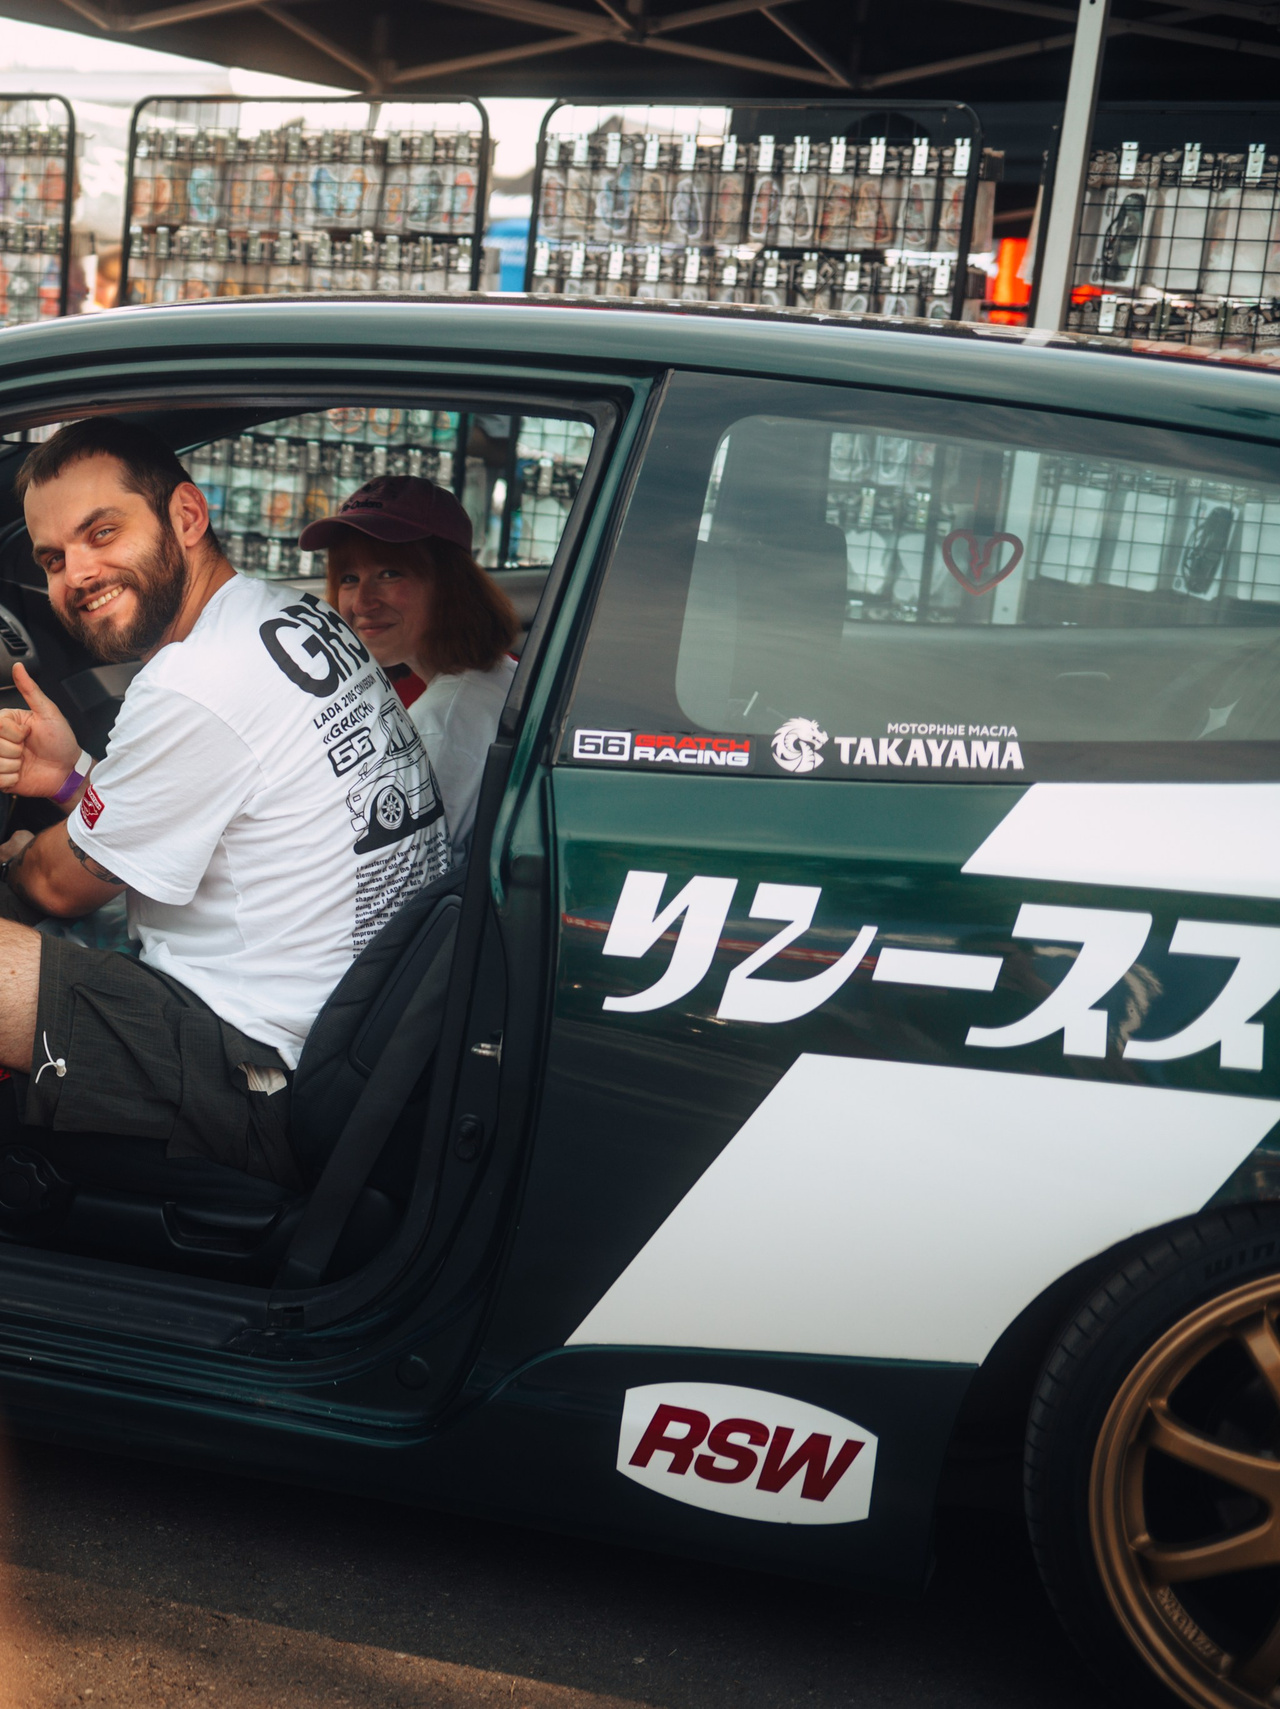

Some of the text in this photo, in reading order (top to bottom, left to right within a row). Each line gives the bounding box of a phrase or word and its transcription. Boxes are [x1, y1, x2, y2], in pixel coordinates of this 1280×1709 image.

[313, 701, 343, 730] LADA
[343, 691, 358, 708] 2105
[635, 734, 750, 753] GRATCH
[887, 722, 1018, 737] МОТОРНЫЕ МАСЛА
[330, 734, 374, 773] 56
[578, 734, 627, 757] 56
[633, 747, 749, 767] RACING
[834, 736, 1025, 770] TAKAYAMA
[628, 1403, 866, 1502] RSW
